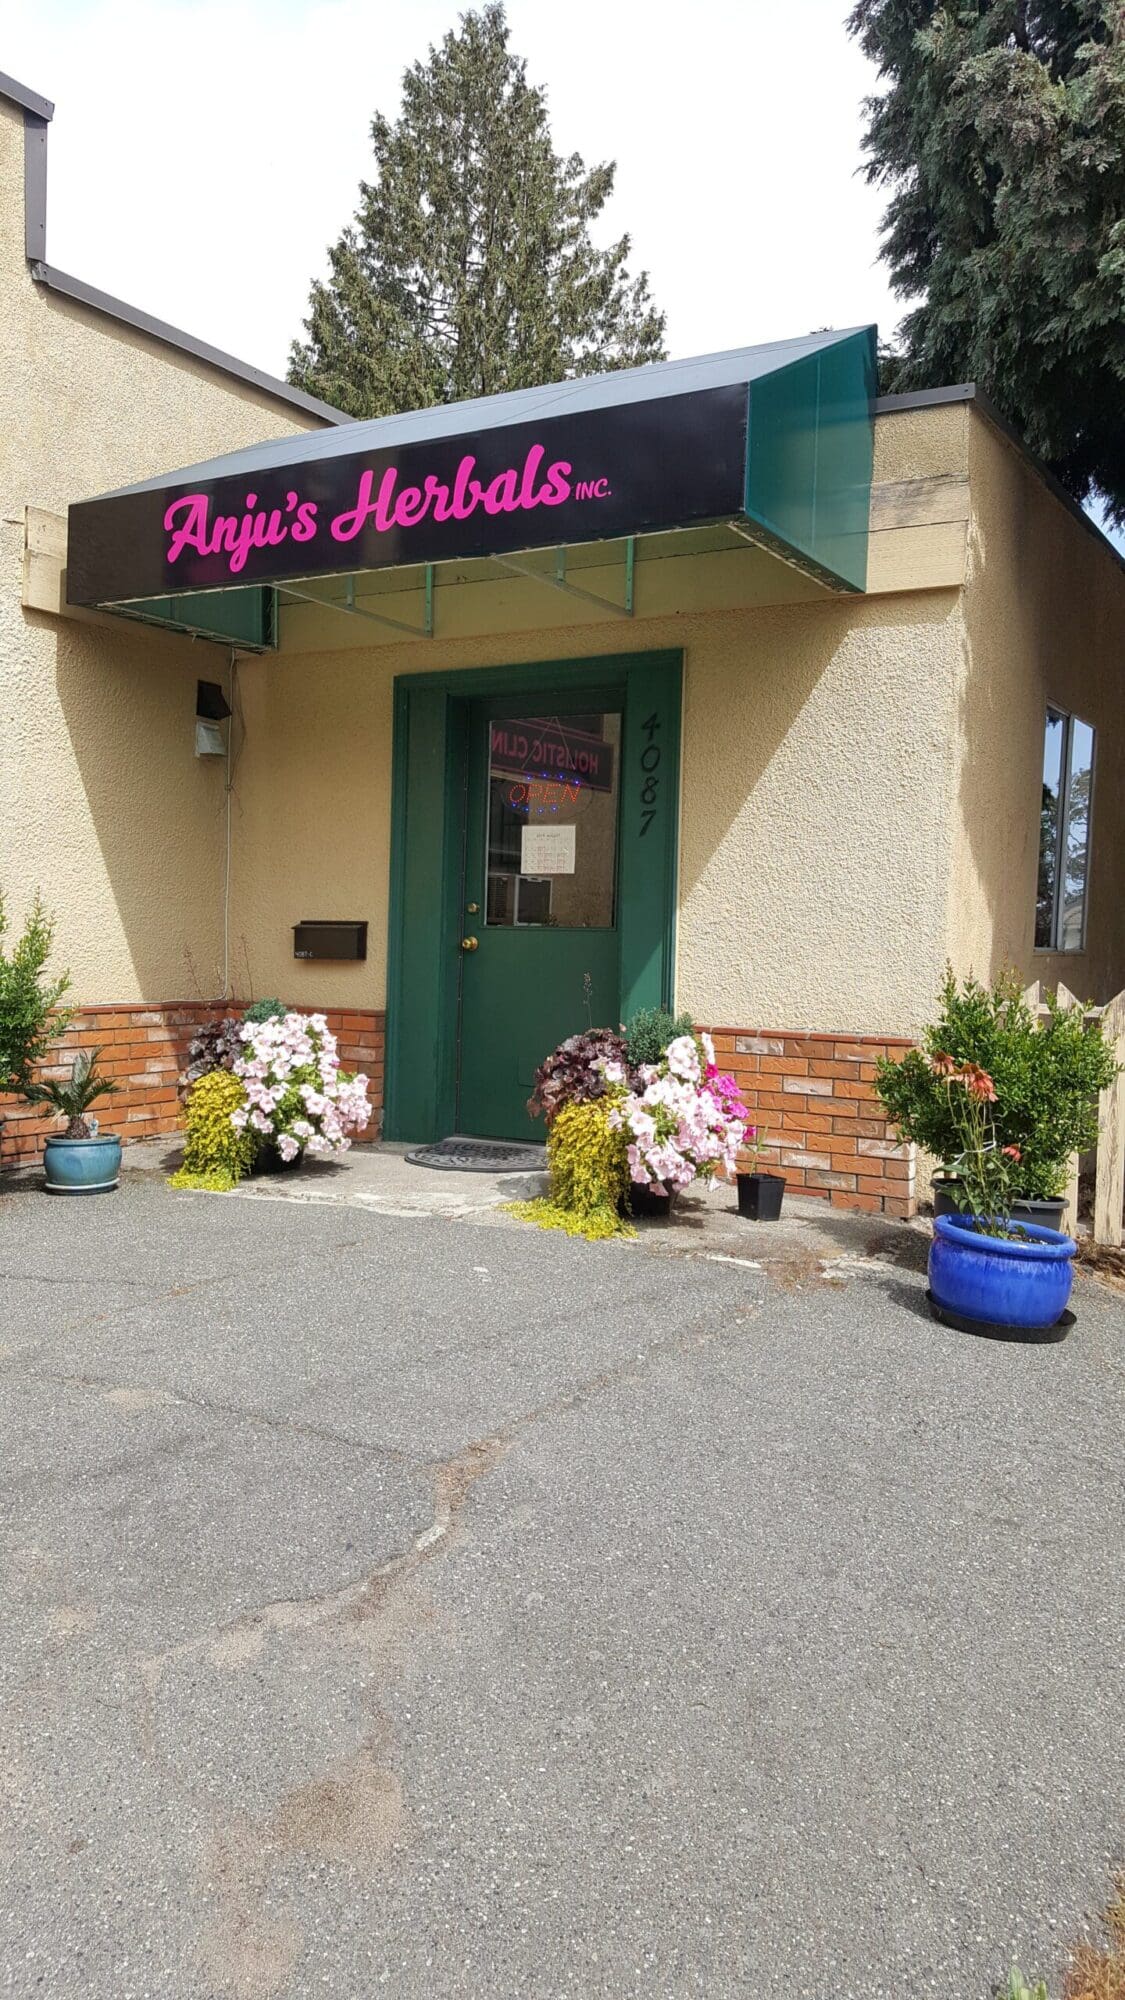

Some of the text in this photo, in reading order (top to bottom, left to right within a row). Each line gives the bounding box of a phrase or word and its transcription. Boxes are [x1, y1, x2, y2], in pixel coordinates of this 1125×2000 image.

[163, 444, 612, 574] Anju's Herbals INC.
[509, 783, 581, 804] OPEN
[640, 712, 661, 837] 4087
